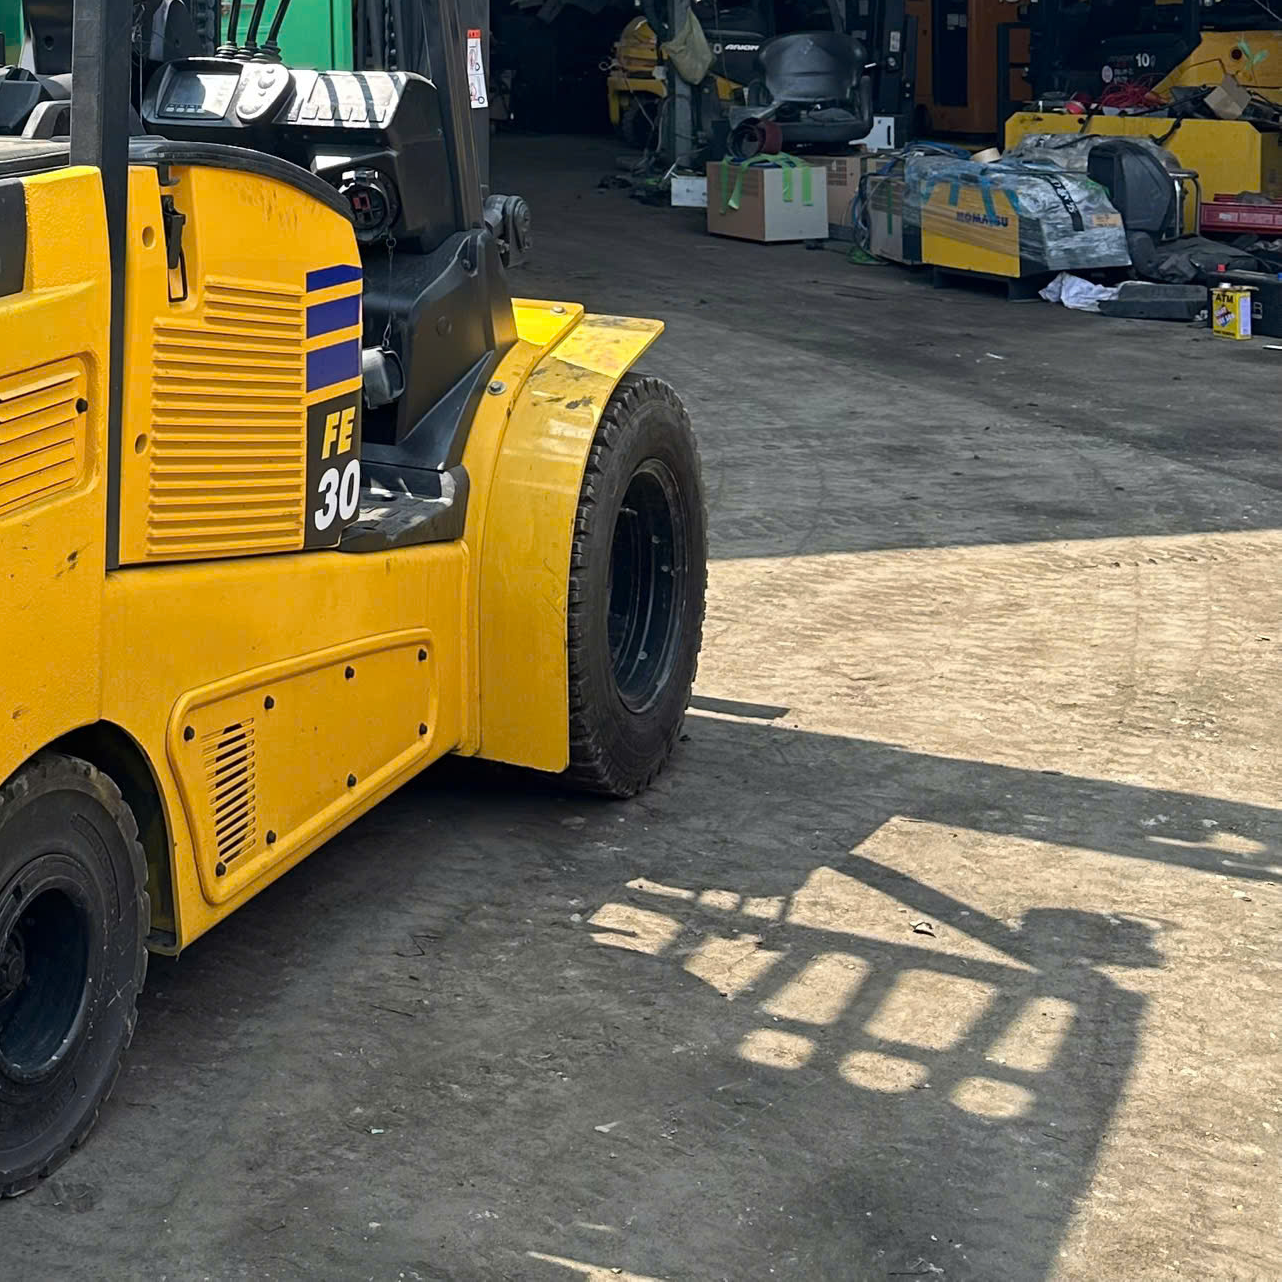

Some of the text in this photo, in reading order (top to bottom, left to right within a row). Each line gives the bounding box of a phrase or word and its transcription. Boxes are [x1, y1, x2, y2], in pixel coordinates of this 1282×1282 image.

[1135, 53, 1150, 68] 10
[1215, 294, 1234, 303] ATM
[321, 406, 356, 460] FE
[314, 459, 361, 531] 30
